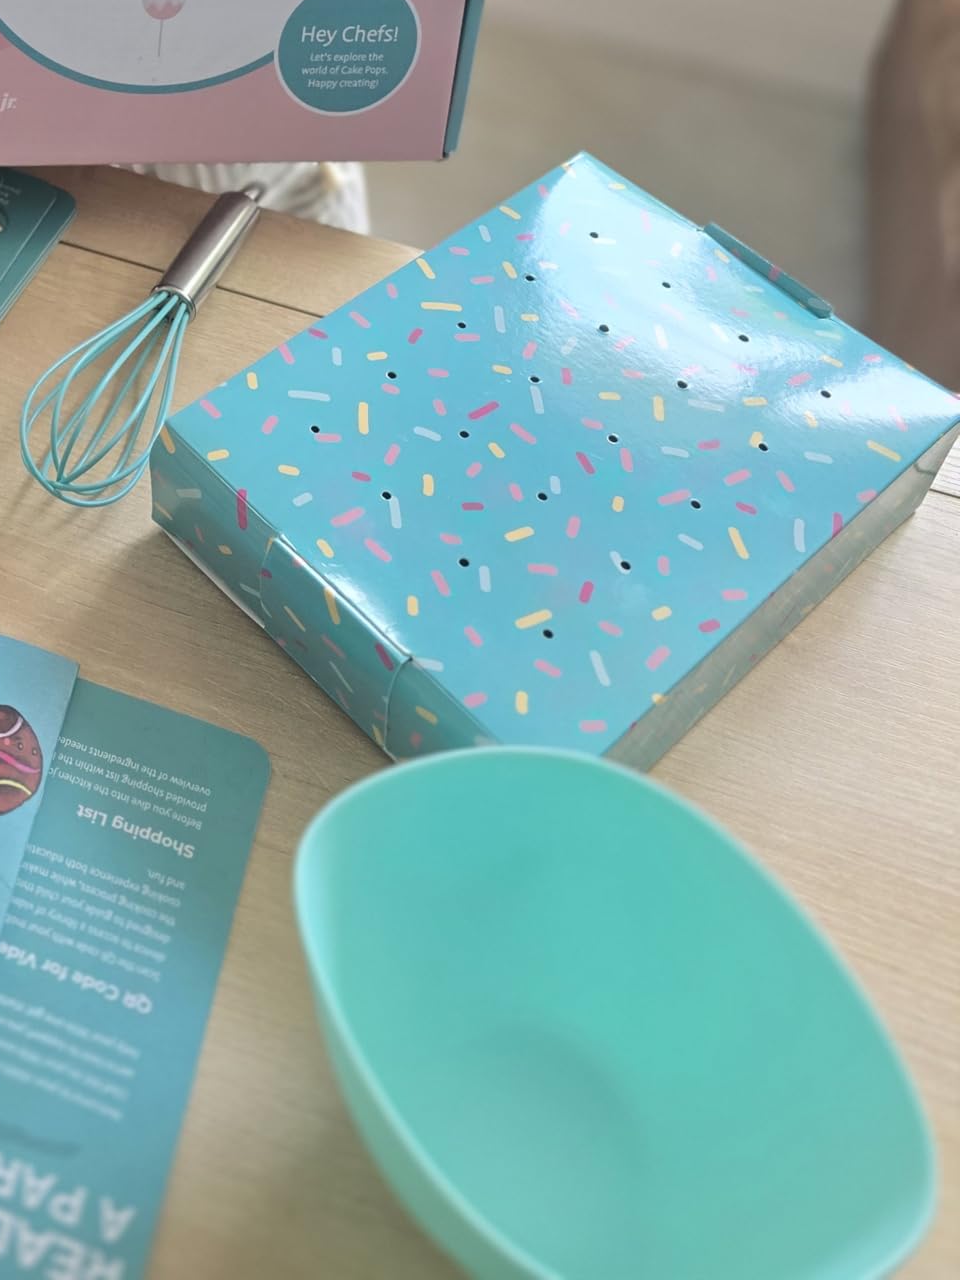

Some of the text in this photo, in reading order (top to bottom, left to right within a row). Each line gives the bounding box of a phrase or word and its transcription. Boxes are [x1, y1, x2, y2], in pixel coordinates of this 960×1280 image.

[301, 25, 399, 47] Hey Chefs!
[310, 53, 384, 65] Let's explore the
[330, 66, 339, 74] of
[341, 66, 363, 74] Cake
[308, 79, 338, 89] Happy
[56, 736, 210, 796] overview of the ingredients neede
[57, 752, 207, 812] provided shopping list within the
[58, 771, 92, 791] kitchen
[93, 783, 109, 797] the
[110, 789, 130, 803] into
[131, 797, 151, 811] dive
[153, 805, 172, 817] you
[173, 812, 202, 830] Before
[76, 804, 195, 859] Shopping List
[64, 857, 88, 873] both
[90, 868, 140, 893] experience
[165, 875, 185, 891] and
[40, 959, 68, 981] for
[72, 970, 120, 1001] Code
[122, 991, 153, 1014] QR
[100, 1198, 136, 1244] A
